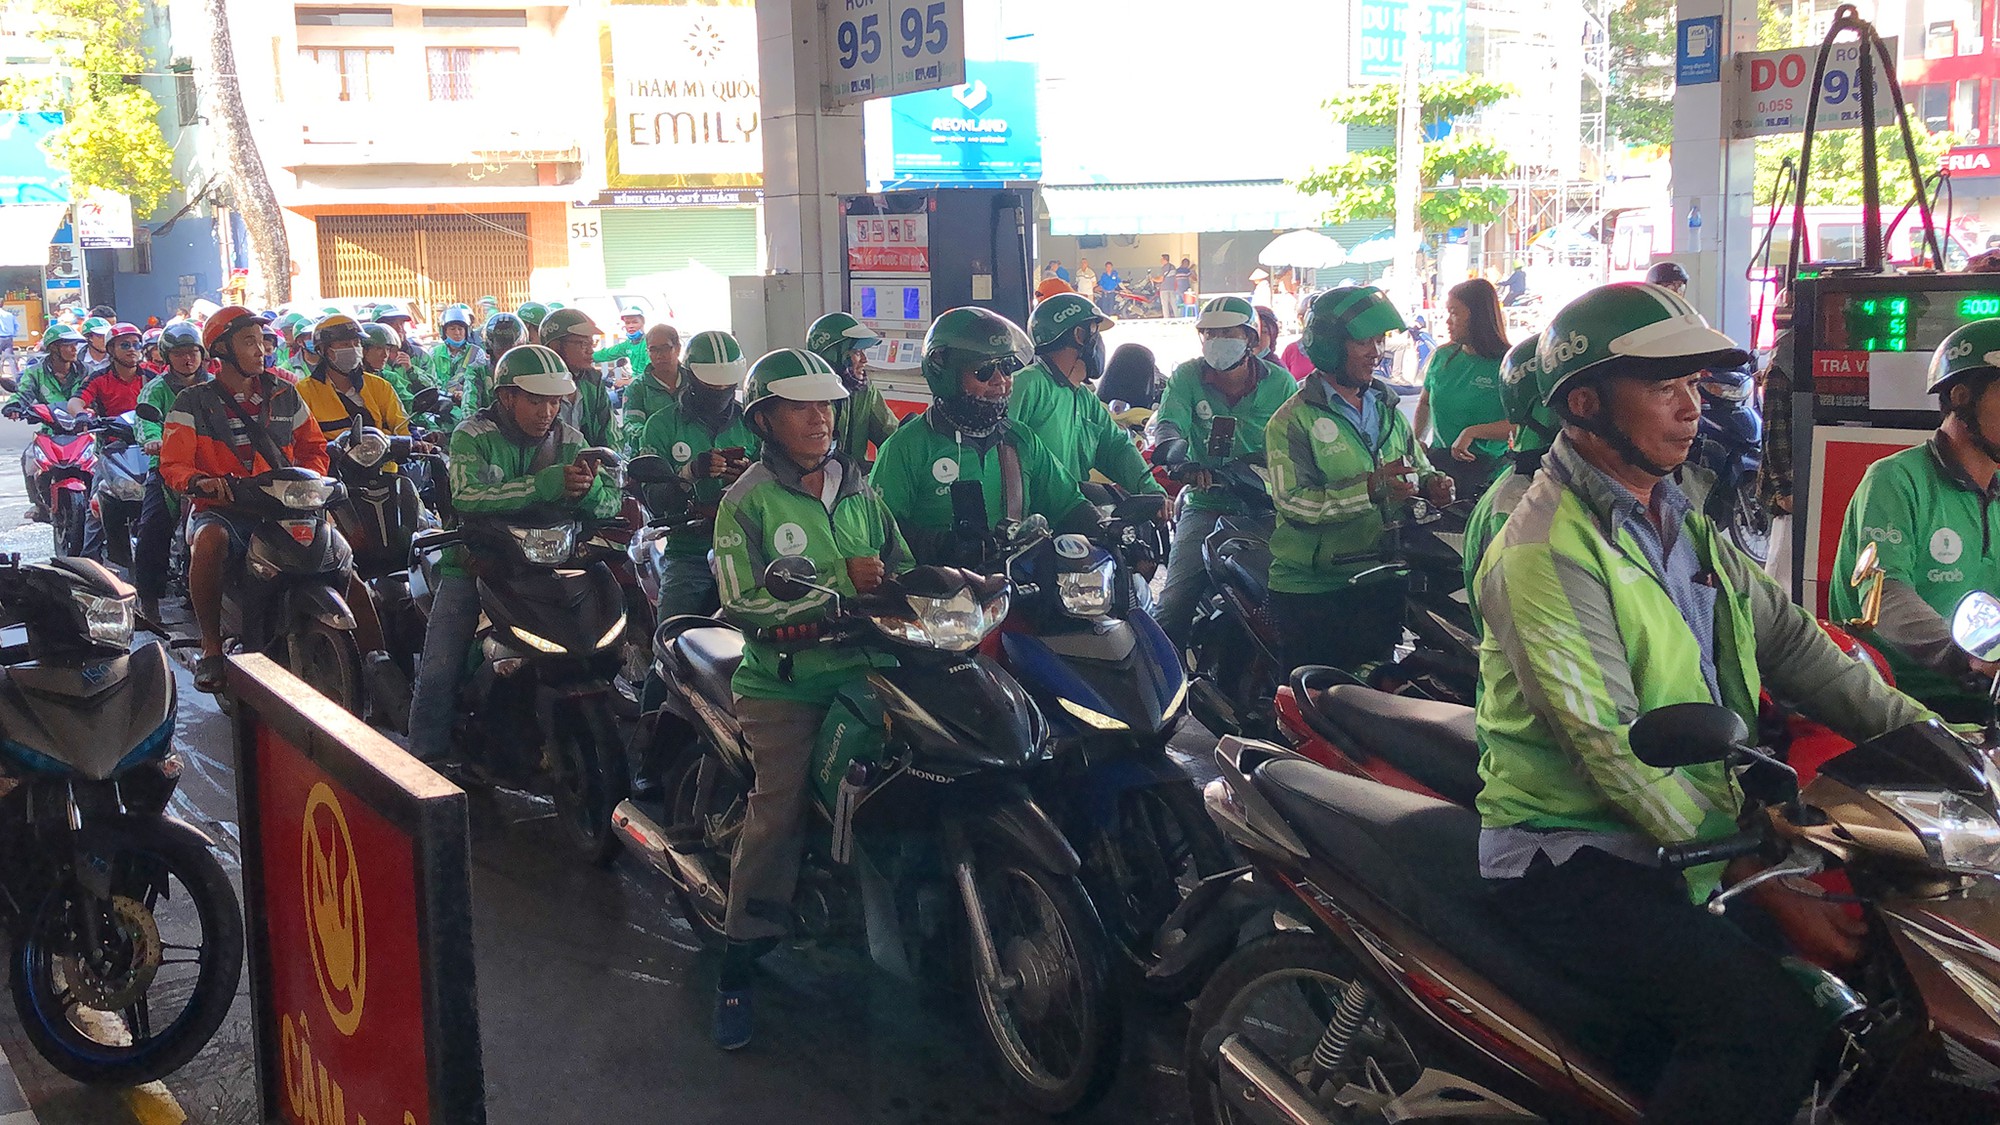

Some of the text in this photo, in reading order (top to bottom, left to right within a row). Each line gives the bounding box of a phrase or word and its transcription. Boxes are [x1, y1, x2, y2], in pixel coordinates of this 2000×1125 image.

[900, 2, 948, 58] 95
[838, 14, 881, 69] 95
[1836, 48, 1859, 61] RO
[1751, 54, 1806, 92] DO
[1758, 98, 1793, 113] 0,05S
[629, 111, 758, 145] EMILY
[932, 117, 1007, 132] AEONLAND
[571, 222, 598, 238] 515
[1053, 303, 1081, 323] Grab
[1961, 299, 2000, 314] 3000
[1541, 331, 1588, 374] Grab
[1506, 356, 1539, 384] Gra
[1820, 354, 1851, 372] TRẢ
[936, 486, 951, 496] Gr
[1861, 522, 1902, 544] rab
[1926, 567, 1964, 583] Grab
